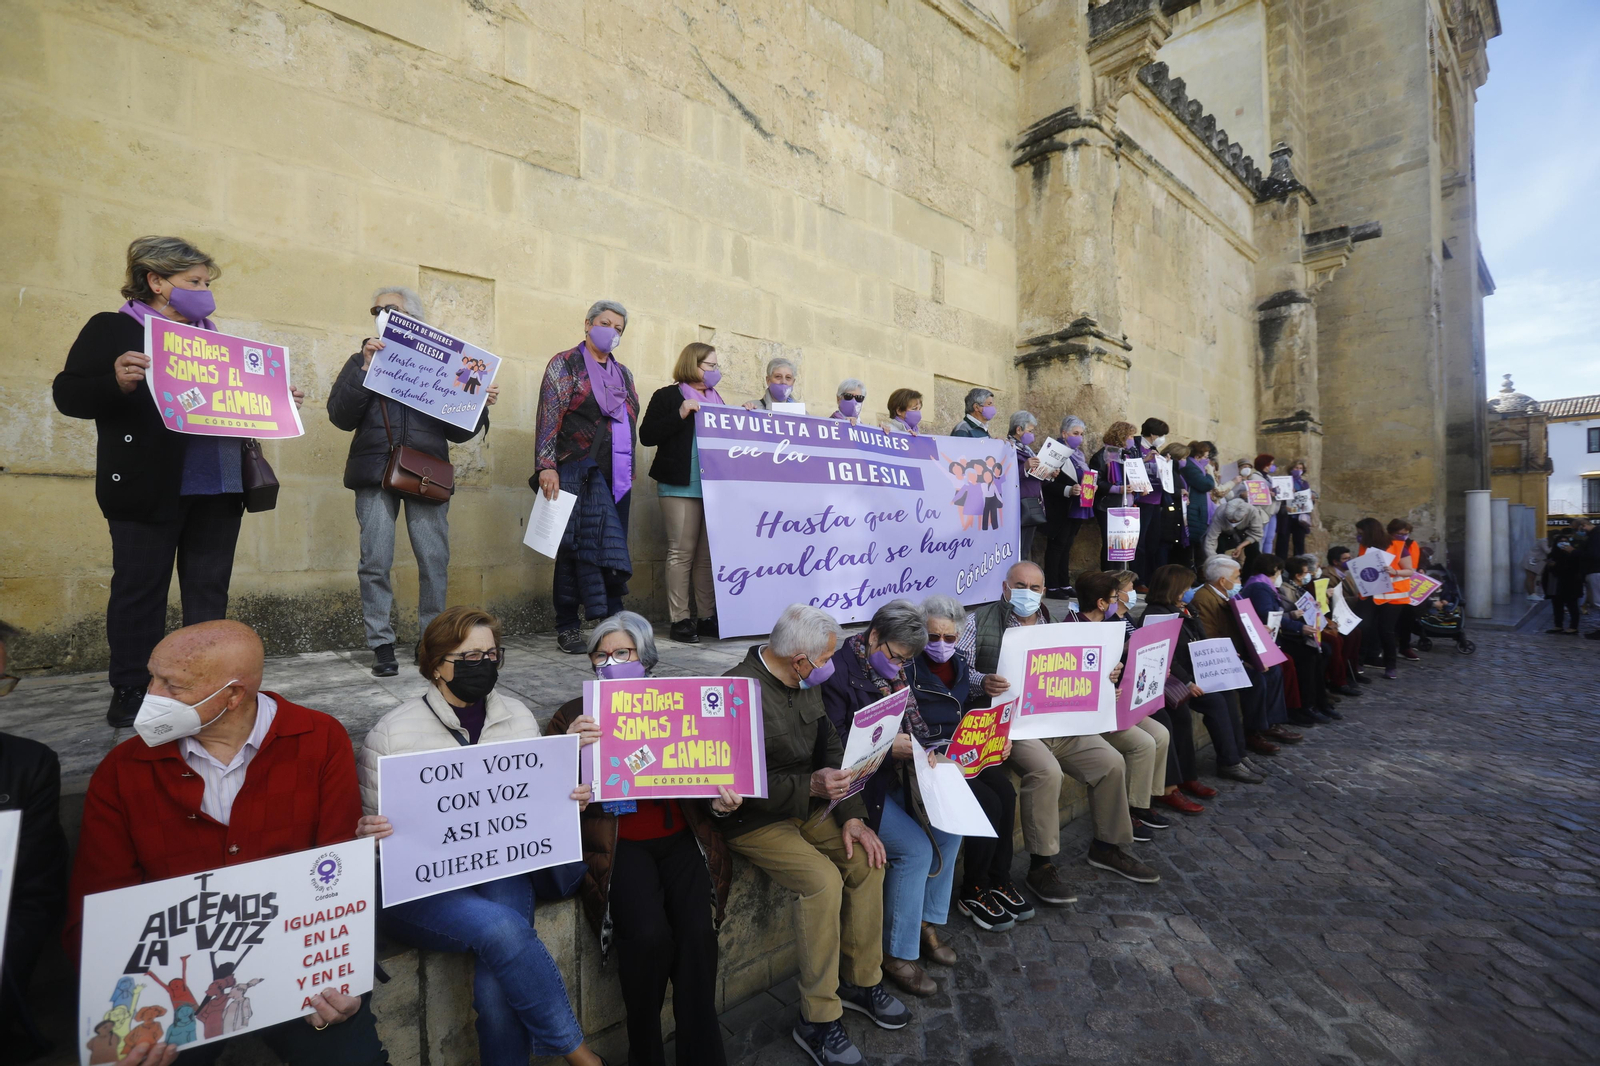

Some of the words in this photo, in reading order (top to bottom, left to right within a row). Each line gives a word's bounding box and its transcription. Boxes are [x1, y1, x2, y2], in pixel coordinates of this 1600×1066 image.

[391, 315, 419, 332] REVUELTA
[420, 326, 428, 335] DE
[428, 330, 453, 347] MUJERES
[403, 330, 415, 340] la
[163, 332, 229, 362] NOSOTRAS
[416, 342, 445, 361] IGLESIA
[166, 356, 219, 384] SOMOS
[228, 367, 243, 387] EL
[388, 352, 416, 368] Hasta
[418, 364, 434, 374] que
[436, 366, 449, 378] la
[373, 365, 419, 385] igualdad
[420, 380, 430, 388] se
[432, 381, 457, 398] haga
[212, 390, 271, 416] CAMBIO
[390, 387, 435, 405] costumbre
[441, 402, 477, 415] Córdoba
[205, 418, 256, 428] CÓRDOBA
[704, 412, 810, 437] REVUELTA
[819, 424, 841, 441] DE
[848, 429, 910, 452] MUJERES
[728, 443, 765, 459] en
[771, 439, 812, 465] la
[828, 461, 911, 487] IGLESIA
[756, 504, 857, 539] Hasta
[863, 506, 909, 532] que
[915, 498, 942, 524] la
[716, 542, 880, 596] igualdad
[884, 544, 914, 562] se
[920, 527, 975, 559] haga
[955, 542, 1013, 595] Córdoba
[808, 567, 938, 610] costumbre
[1030, 652, 1077, 676] DIGNIDAD
[1038, 675, 1045, 689] E
[1046, 677, 1092, 700] IGUALDAD
[611, 688, 684, 714] NOSOTRAS
[613, 715, 671, 740] SOMOS
[682, 714, 699, 737] EL
[957, 729, 989, 745] SOMOS
[662, 740, 731, 768] CAMBIO
[419, 762, 464, 784] CON
[483, 752, 543, 774] VOTO,
[653, 776, 710, 784] CÓRDOBA
[437, 790, 480, 813] CON
[487, 782, 529, 804] VOZ
[442, 821, 480, 844] ASI
[487, 813, 528, 836] NOS
[310, 853, 328, 876] Mujeres
[328, 851, 343, 876] Cristianas
[415, 849, 499, 883] QUIERE
[506, 838, 552, 863] DIOS
[315, 892, 338, 901] Córdoba
[139, 892, 278, 942] ALCEMOS
[284, 900, 367, 932] IGUALDAD
[123, 940, 169, 974] LA
[195, 920, 272, 952] VOZ
[303, 932, 325, 948] EN
[330, 924, 349, 940] LA
[302, 943, 350, 968] CALLE
[296, 978, 307, 990] Y
[311, 970, 333, 987] EN
[338, 962, 355, 977] EL
